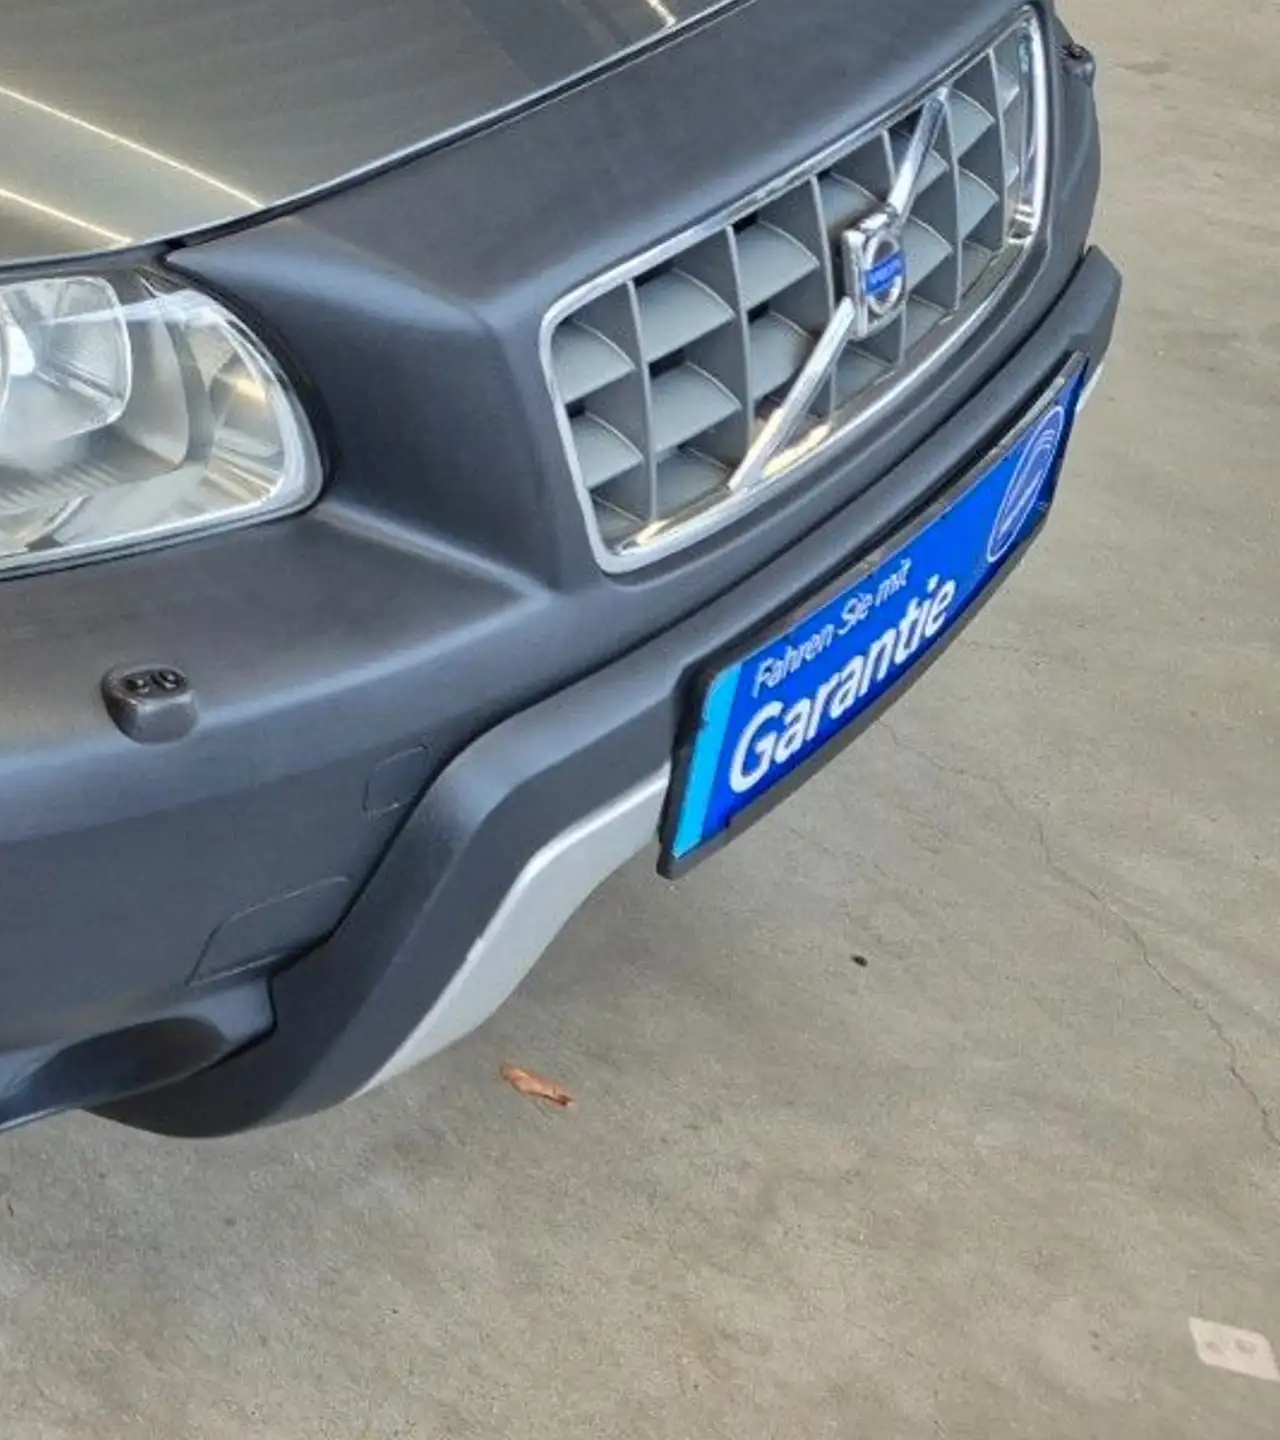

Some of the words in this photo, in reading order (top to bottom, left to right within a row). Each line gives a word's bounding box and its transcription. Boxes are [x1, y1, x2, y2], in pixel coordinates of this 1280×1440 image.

[729, 574, 956, 793] Garantie
[752, 624, 835, 698] Fahren
[837, 593, 873, 635] Sie
